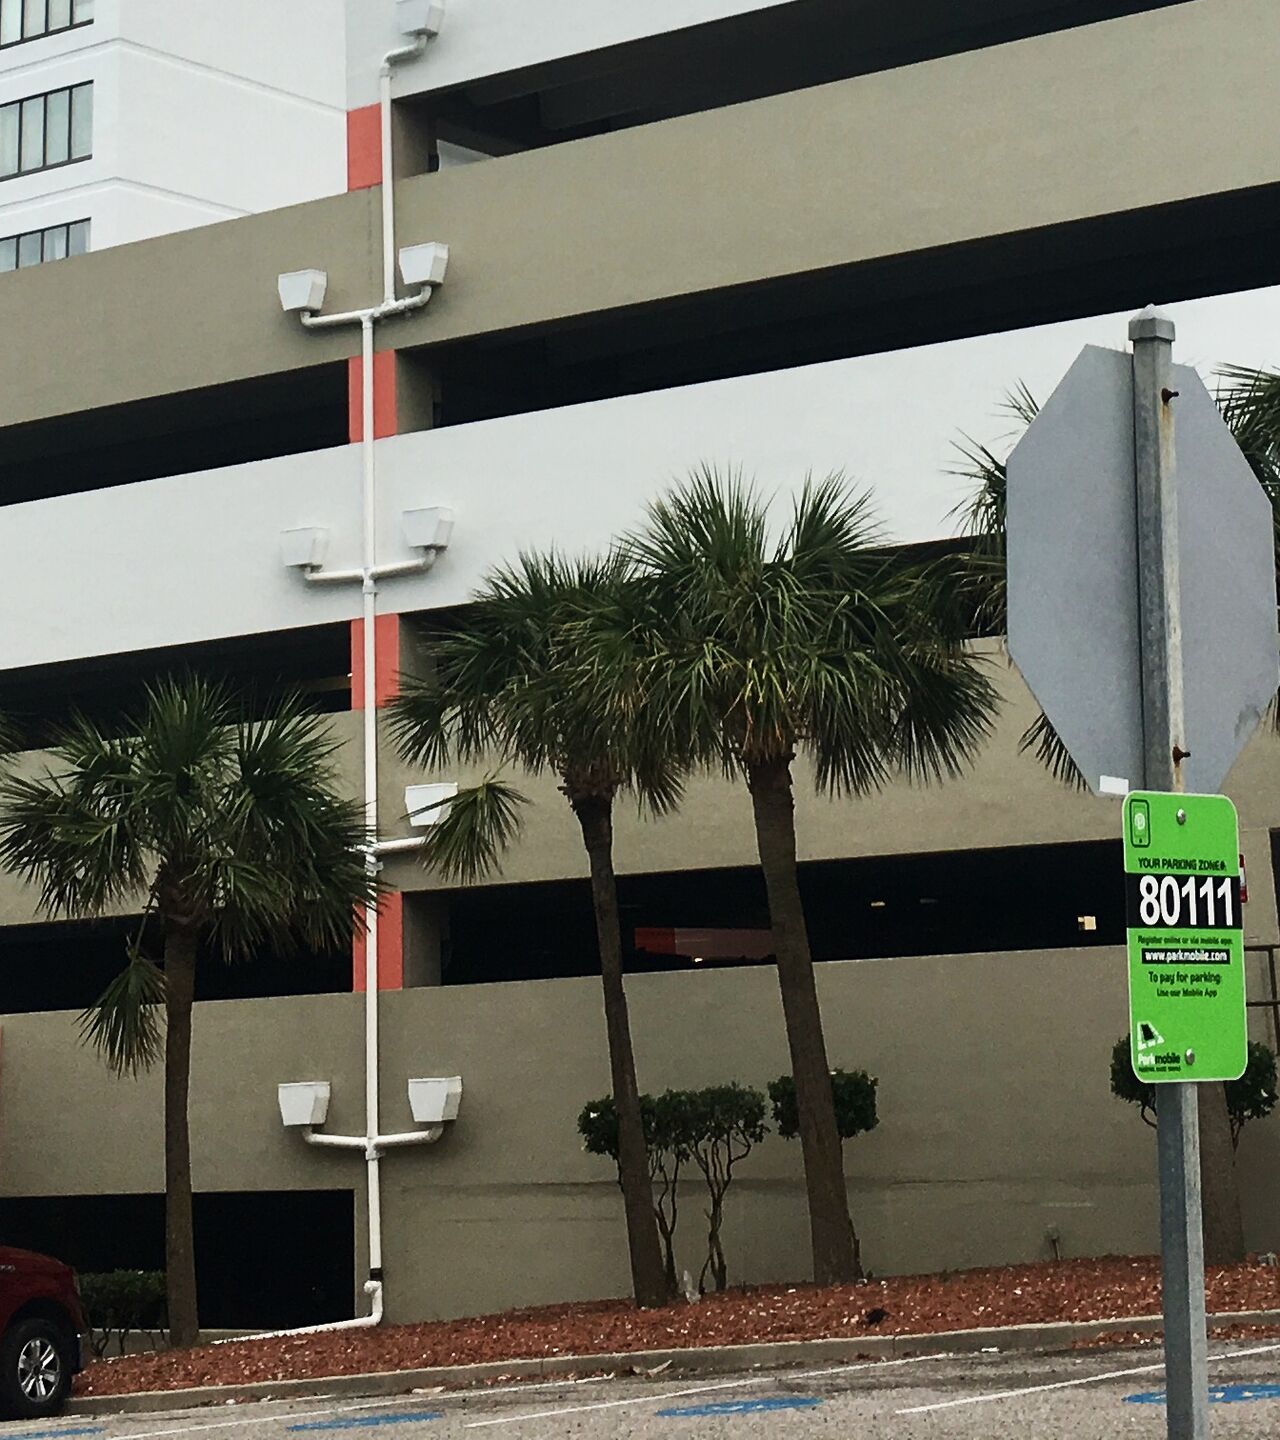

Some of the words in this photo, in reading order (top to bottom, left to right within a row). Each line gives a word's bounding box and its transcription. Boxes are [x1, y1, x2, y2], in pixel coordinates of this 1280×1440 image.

[1138, 857, 1160, 869] YOUR
[1162, 859, 1196, 870] PARKING
[1140, 874, 1233, 927] 80111
[1145, 949, 1227, 963] www.parkmobile.com
[1148, 971, 1158, 982] To
[1160, 973, 1175, 985] pay
[1176, 971, 1188, 982] for
[1204, 988, 1217, 998] App
